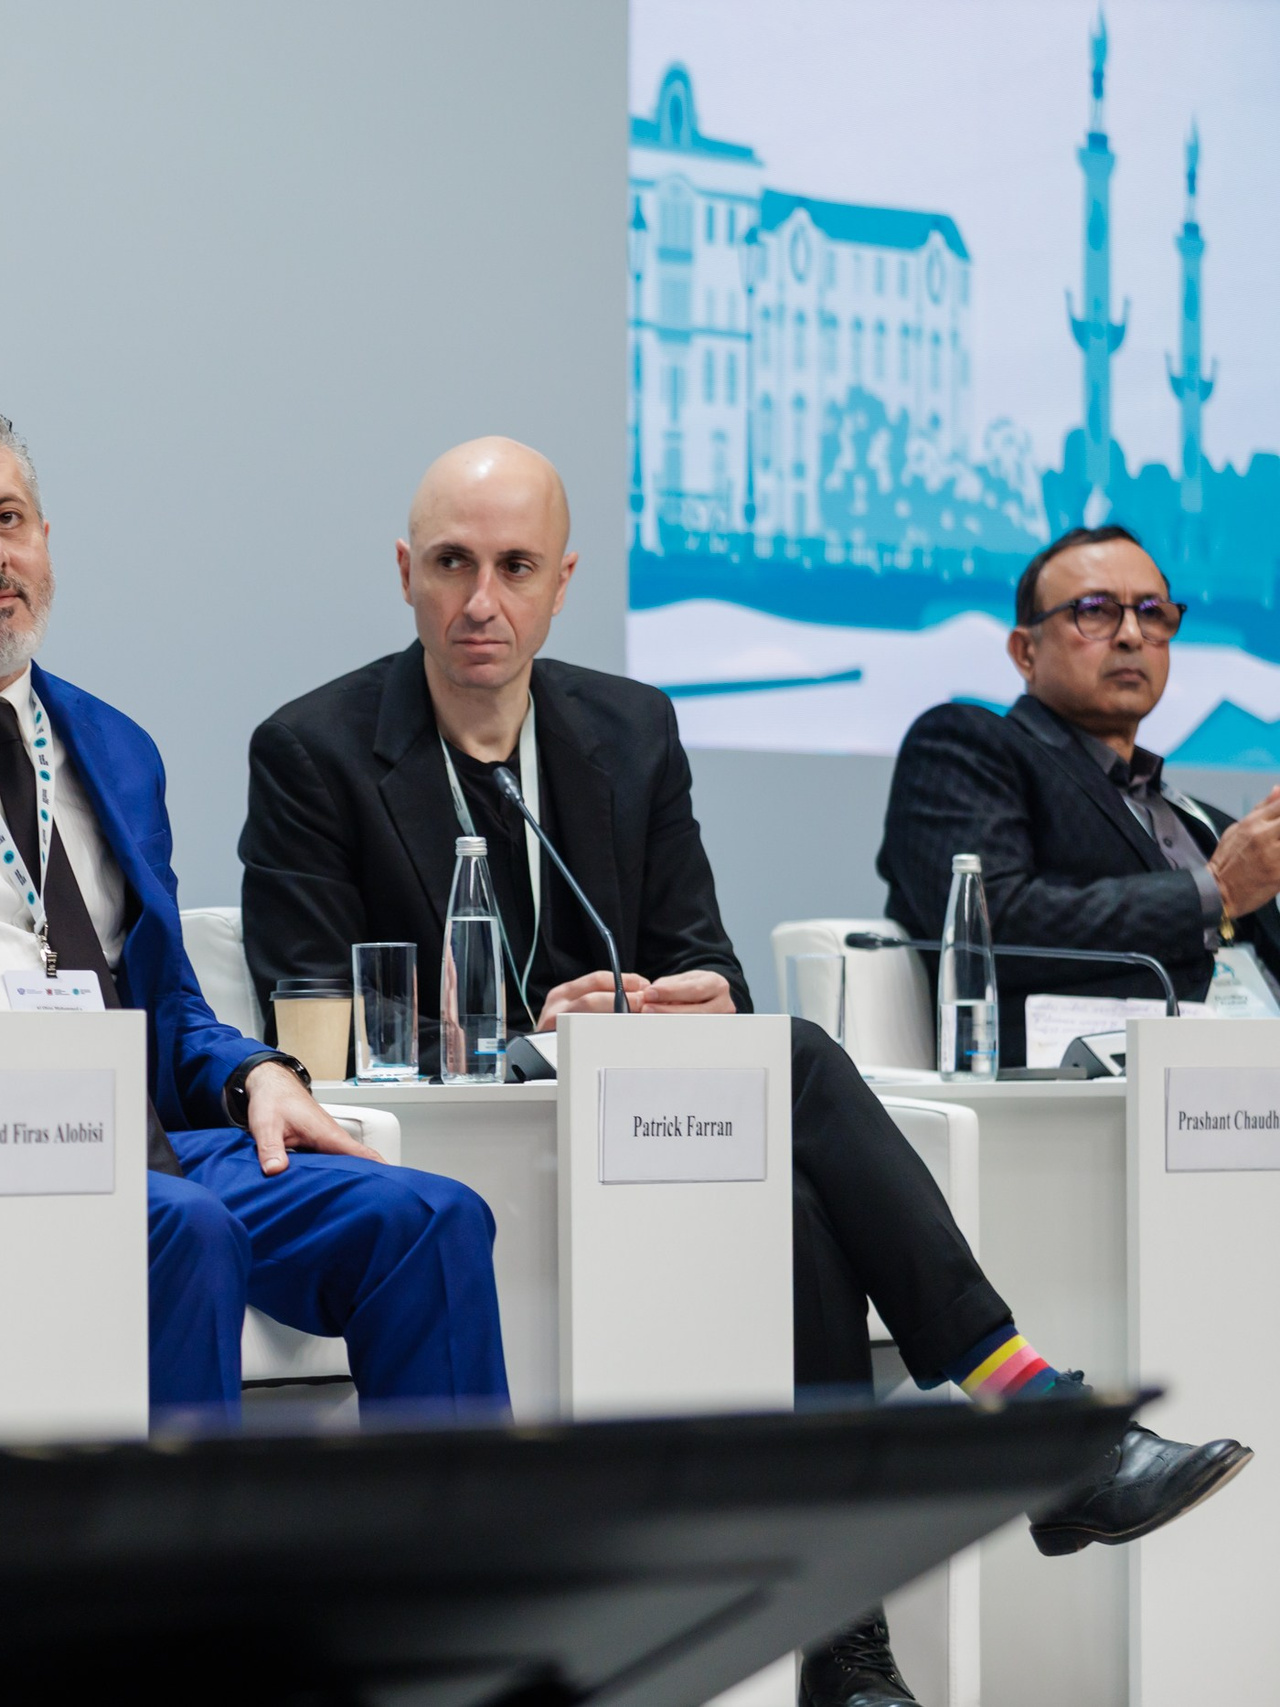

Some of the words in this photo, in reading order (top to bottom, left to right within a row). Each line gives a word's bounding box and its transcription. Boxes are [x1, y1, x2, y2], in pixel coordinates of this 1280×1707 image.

[633, 1115, 683, 1137] Patrick
[686, 1115, 733, 1137] Farran
[1178, 1110, 1231, 1130] Prashant
[13, 1123, 49, 1144] Firas
[54, 1122, 103, 1143] Alobisi
